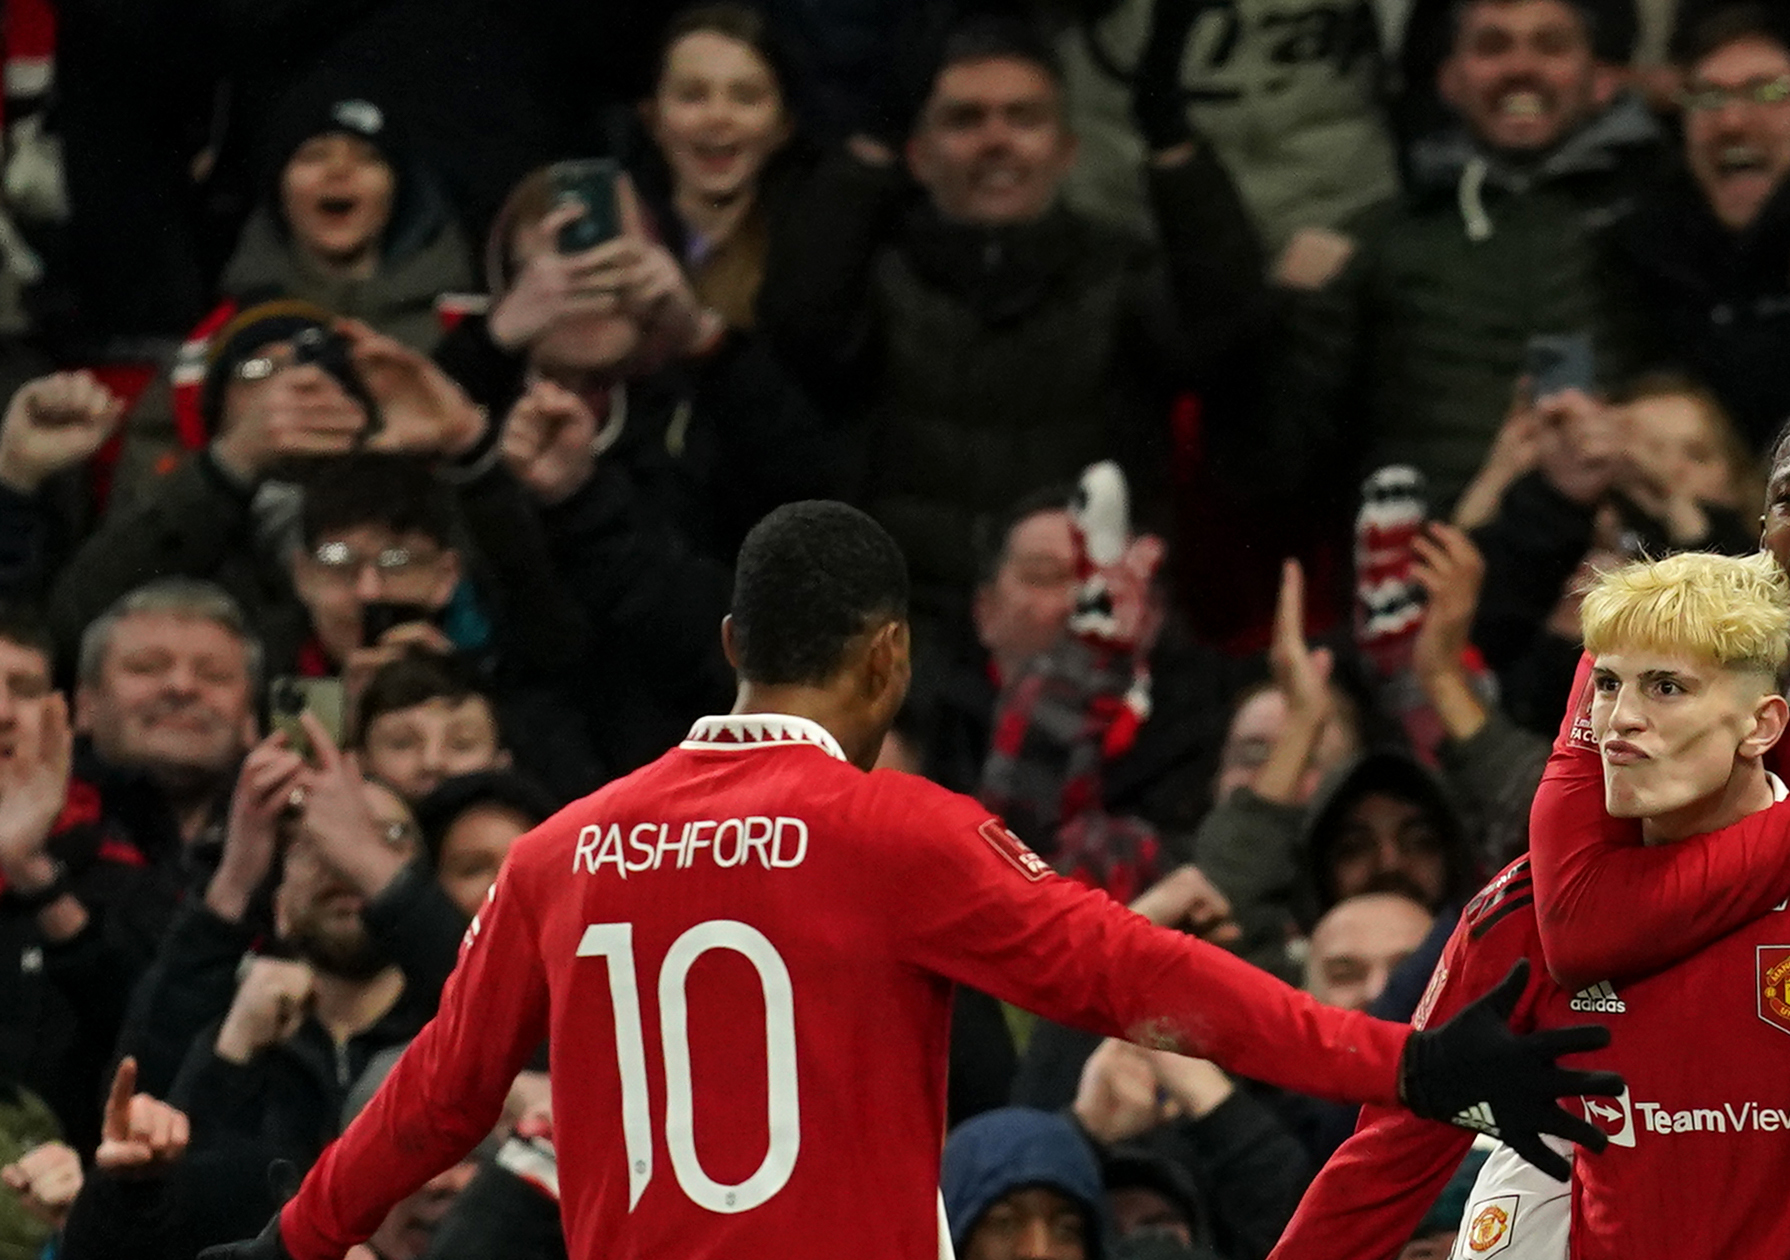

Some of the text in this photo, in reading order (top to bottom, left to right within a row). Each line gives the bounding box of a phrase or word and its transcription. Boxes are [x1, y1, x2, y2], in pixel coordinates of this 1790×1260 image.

[573, 816, 808, 879] RASHFORD
[1570, 997, 1626, 1013] adidas
[576, 919, 801, 1214] 10
